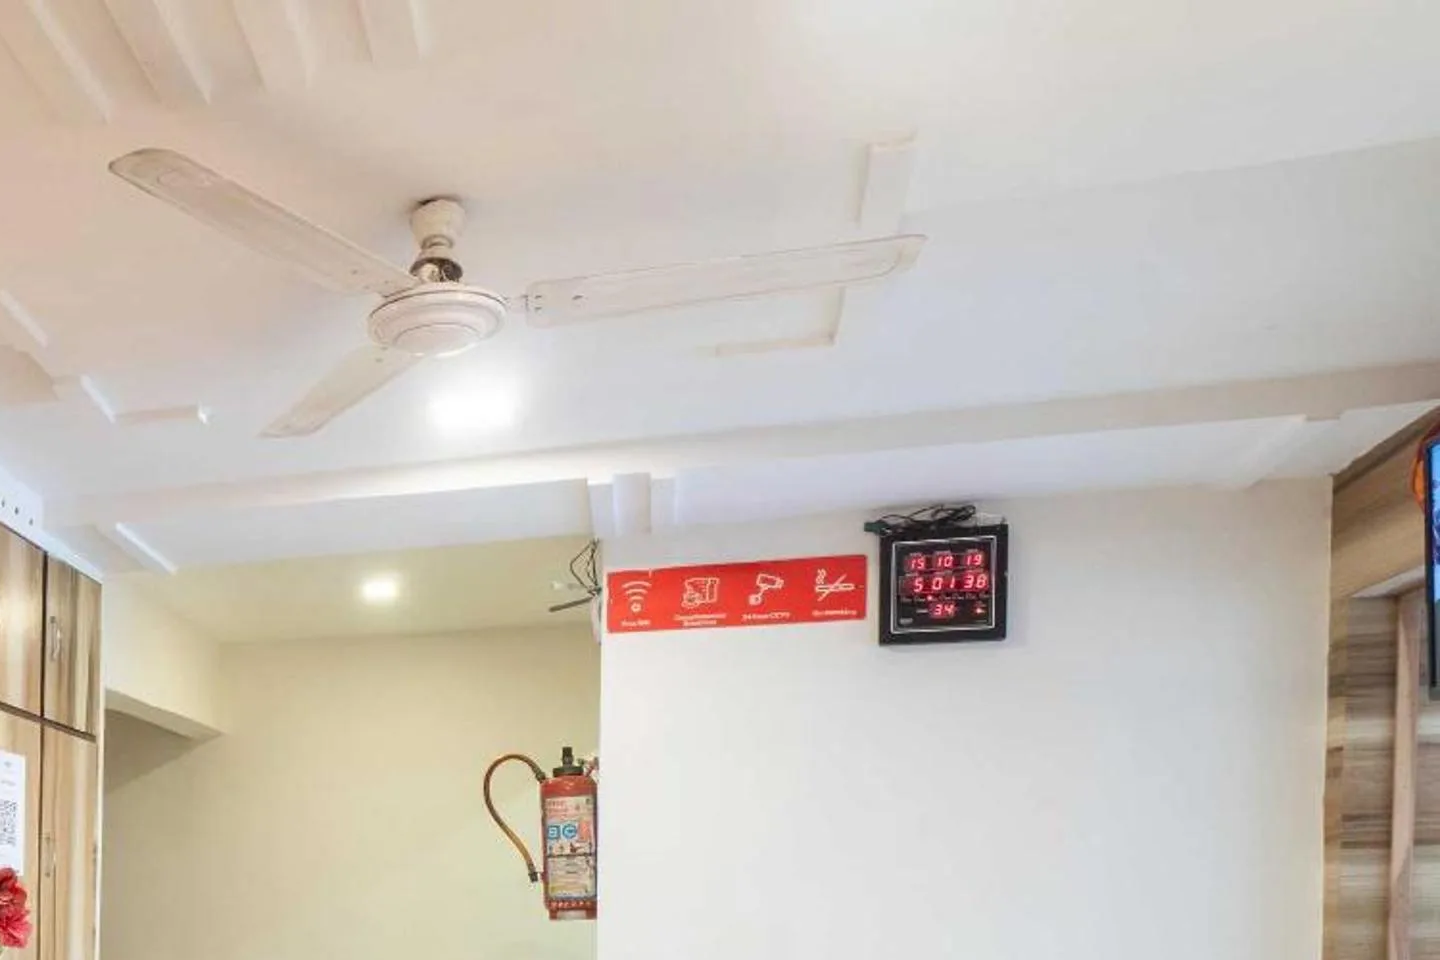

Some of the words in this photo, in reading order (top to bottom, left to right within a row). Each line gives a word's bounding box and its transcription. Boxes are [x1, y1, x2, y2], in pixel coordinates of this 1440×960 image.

[911, 557, 925, 569] 15
[937, 556, 954, 567] 10
[966, 554, 983, 566] 19
[932, 576, 956, 590] 01
[934, 603, 954, 616] 34
